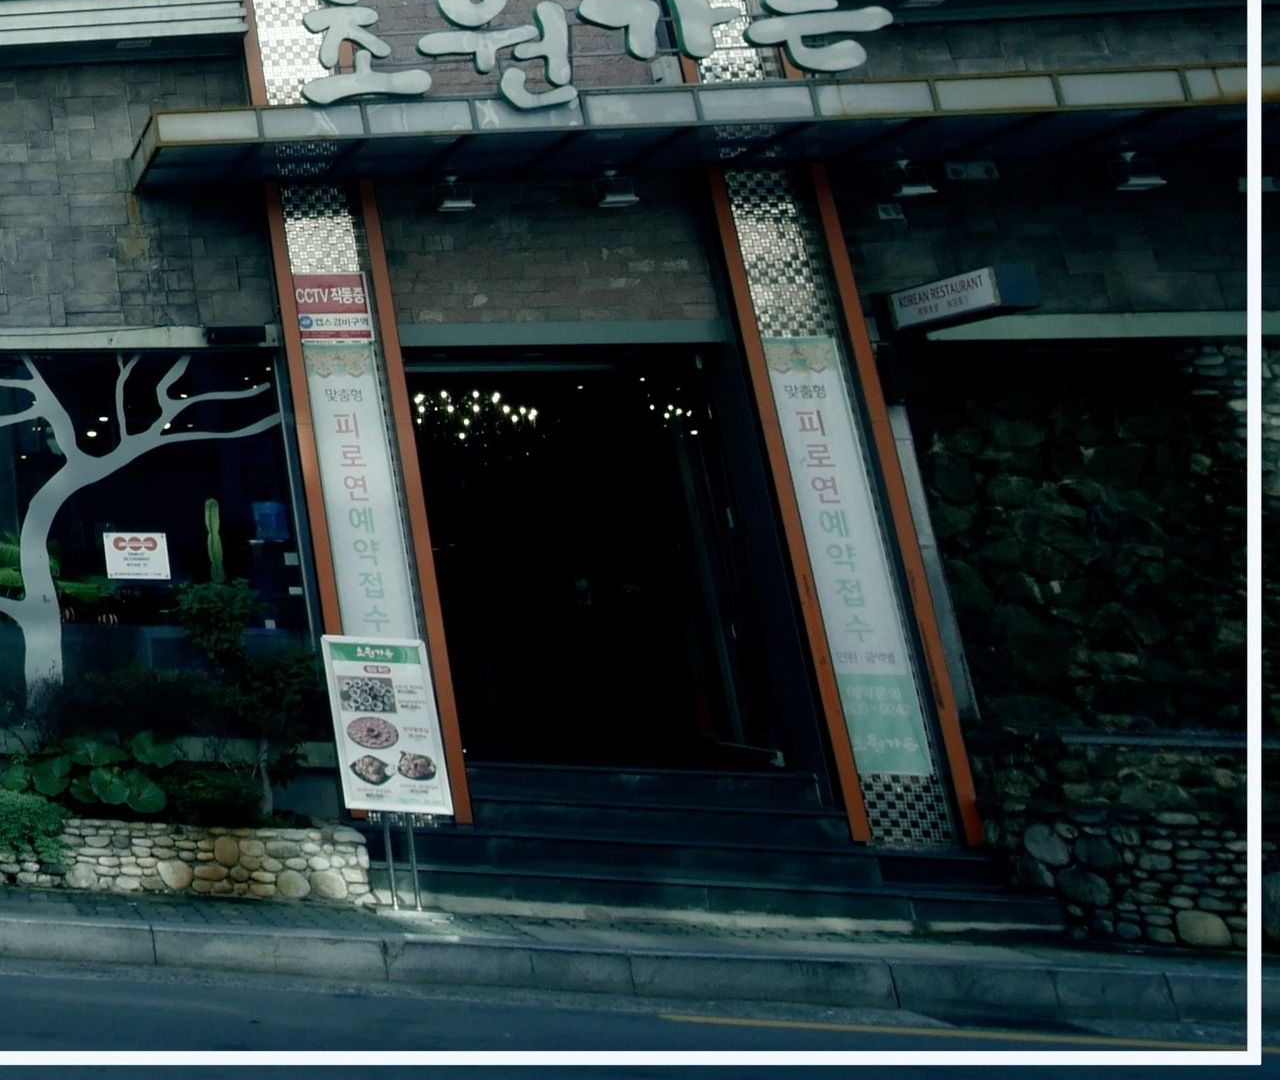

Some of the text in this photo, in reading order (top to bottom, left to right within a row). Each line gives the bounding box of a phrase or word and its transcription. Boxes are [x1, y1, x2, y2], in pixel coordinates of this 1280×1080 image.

[295, 286, 365, 305] CCTV 작동중
[898, 290, 930, 308] KOREAN
[930, 275, 983, 299] RESTAURANT
[324, 387, 364, 403] 맞춤형
[783, 383, 827, 400] 맞춤형
[333, 412, 391, 633] 피로연예약접수
[795, 409, 875, 643] 피로연예약접수
